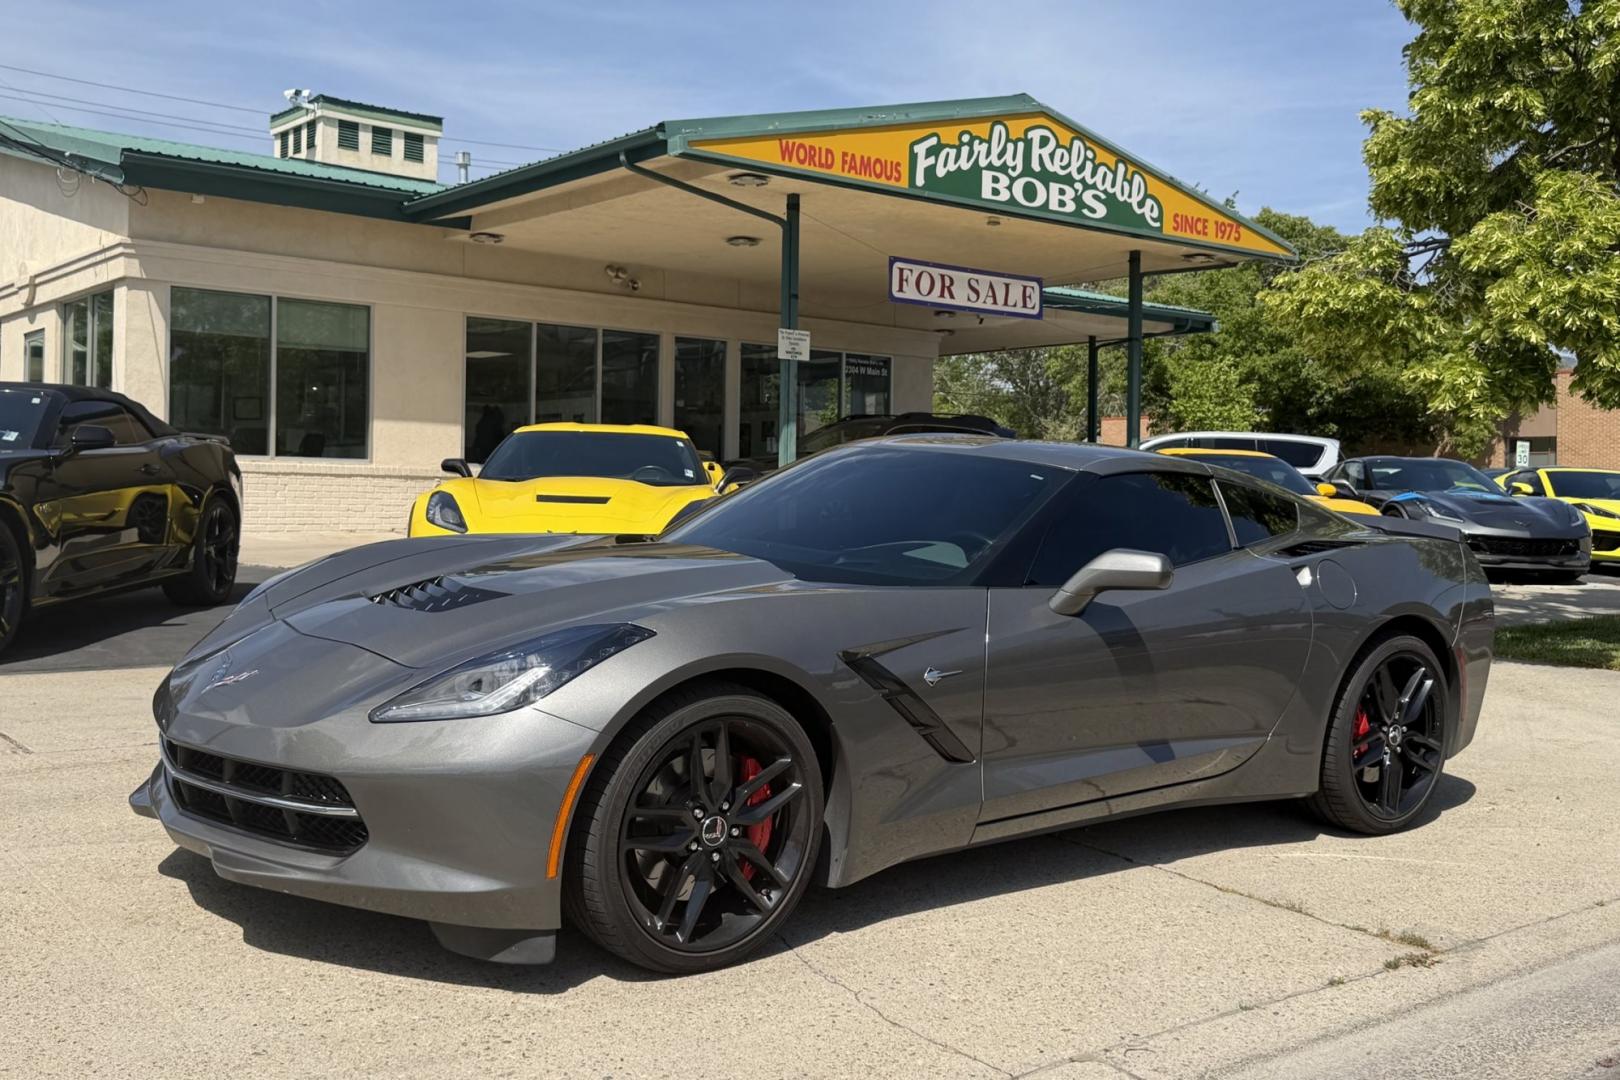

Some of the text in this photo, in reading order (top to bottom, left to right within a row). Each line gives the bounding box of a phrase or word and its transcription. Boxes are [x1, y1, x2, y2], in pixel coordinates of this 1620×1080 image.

[779, 138, 902, 183] WORLD FAMOUS
[913, 124, 1161, 227] Fairly Reliable
[981, 169, 1107, 219] BOB'S
[1172, 213, 1241, 242] SINCE 1975
[896, 267, 1036, 310] FOR SALE
[860, 366, 867, 375] W
[867, 367, 881, 377] Main
[1517, 454, 1528, 464] 30
